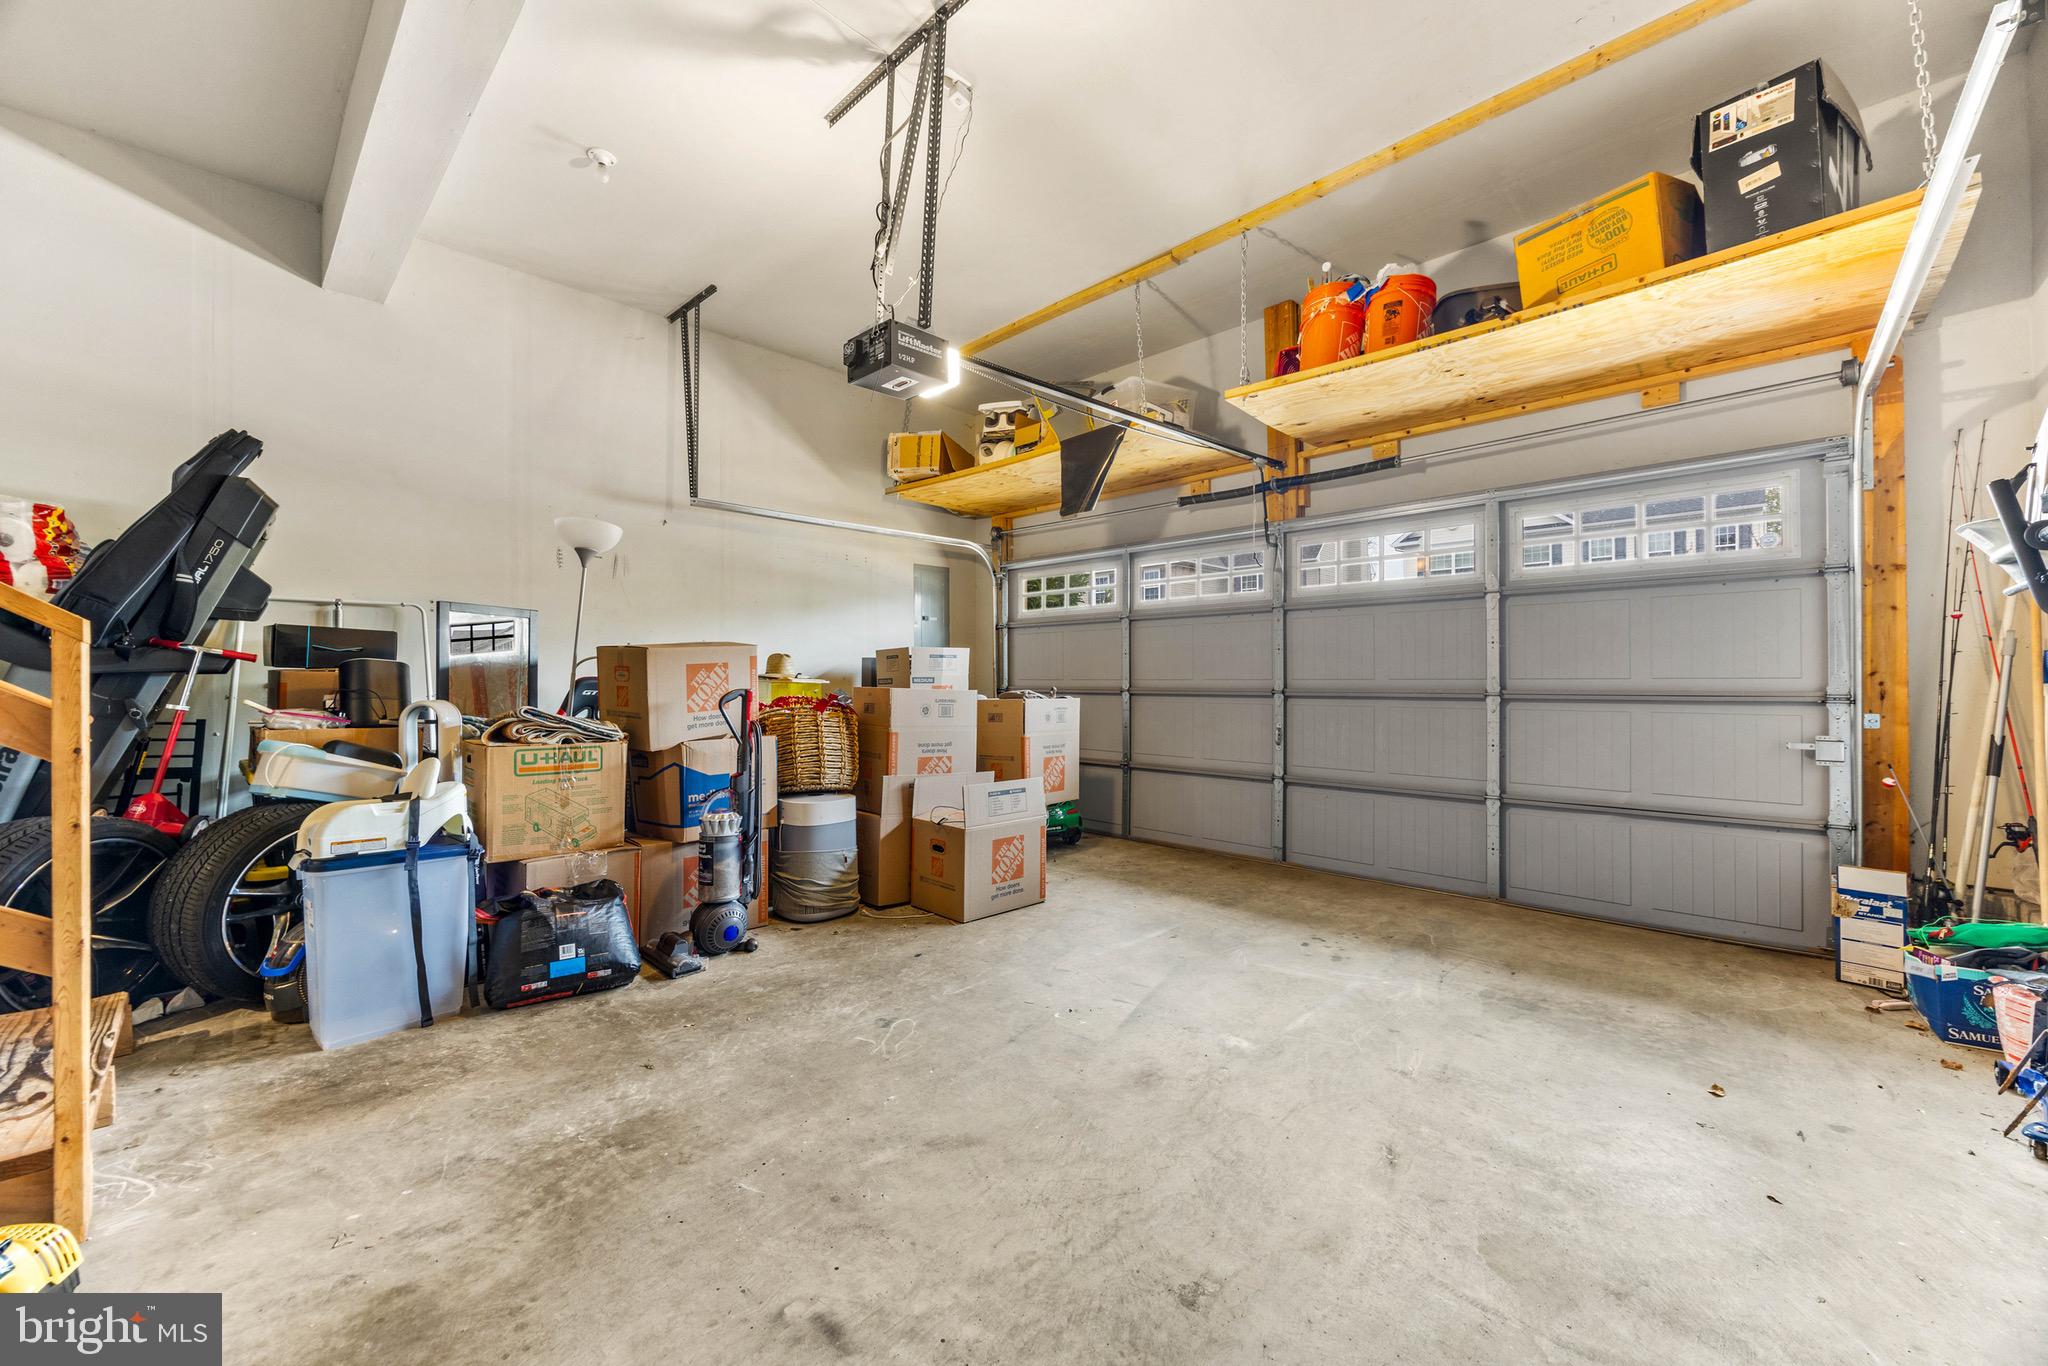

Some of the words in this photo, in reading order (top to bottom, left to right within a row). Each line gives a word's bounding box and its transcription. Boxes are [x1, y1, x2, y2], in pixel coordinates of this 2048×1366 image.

[204, 539, 225, 565] 1750
[688, 663, 727, 711] HOME
[691, 668, 711, 688] THE
[521, 751, 598, 765] U-HAUL
[992, 835, 1025, 884] HOME
[1948, 1028, 2001, 1044] SAMUE
